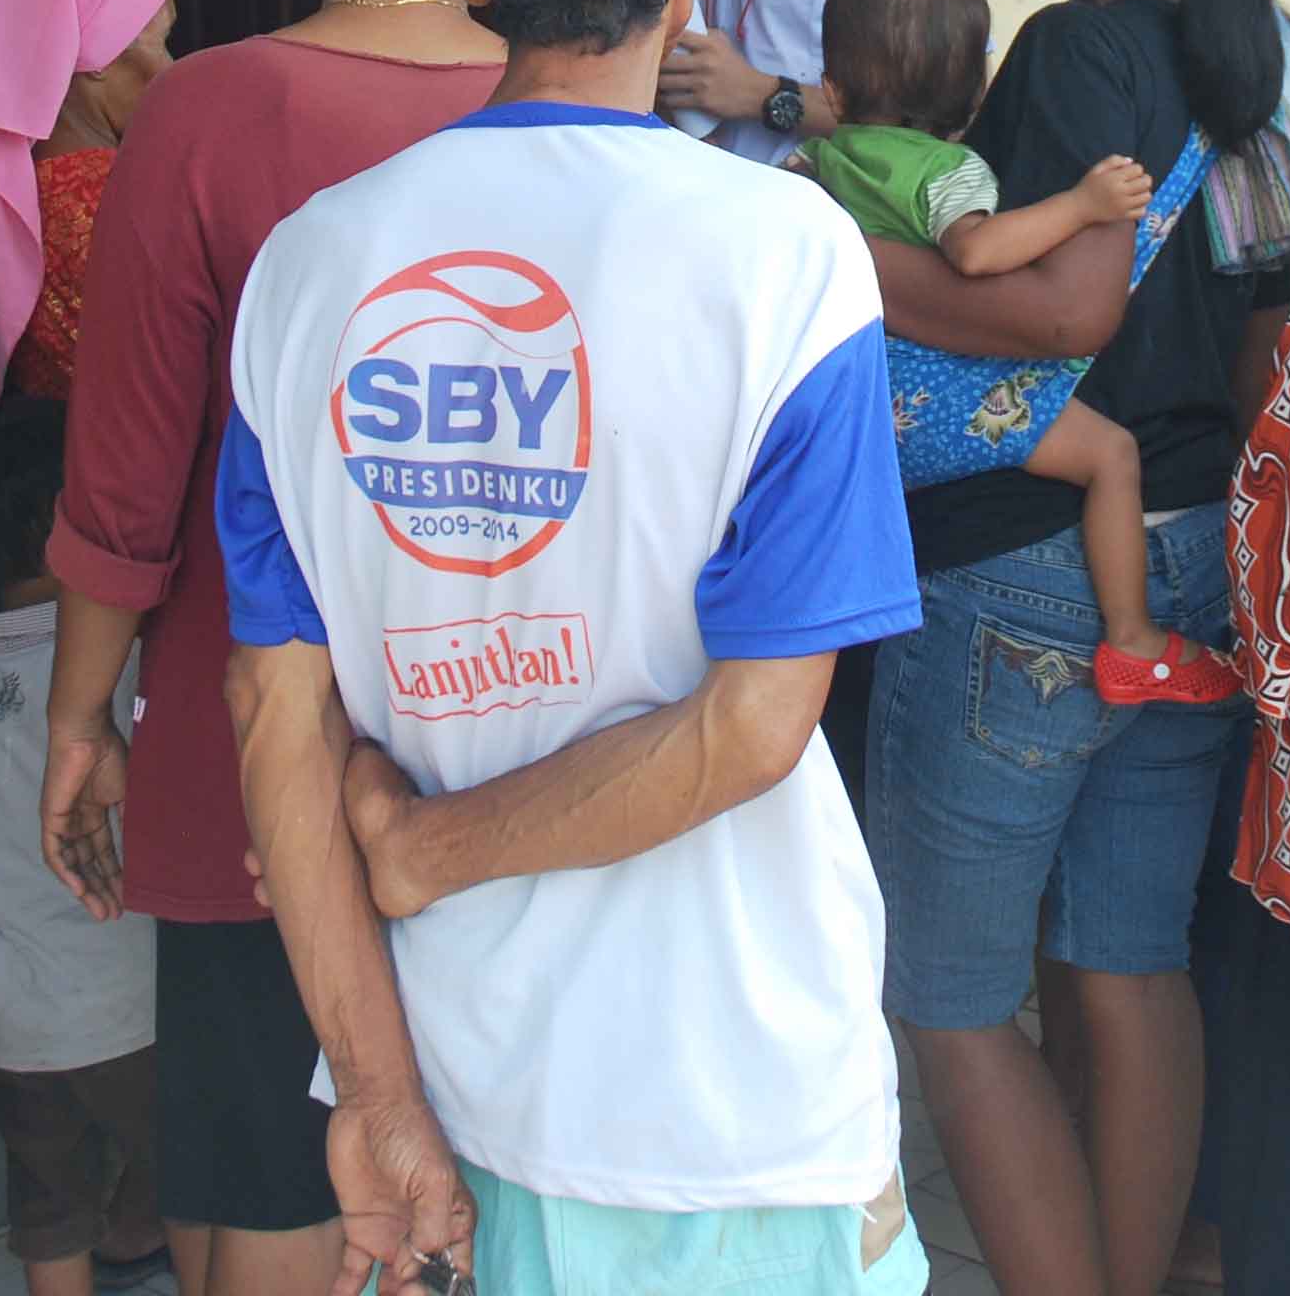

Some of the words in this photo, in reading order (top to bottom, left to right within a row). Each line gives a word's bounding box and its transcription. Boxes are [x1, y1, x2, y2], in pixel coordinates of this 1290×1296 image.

[346, 357, 572, 451] SBY
[364, 462, 569, 507] PRESIDENKU
[409, 514, 519, 542] 2009-2014
